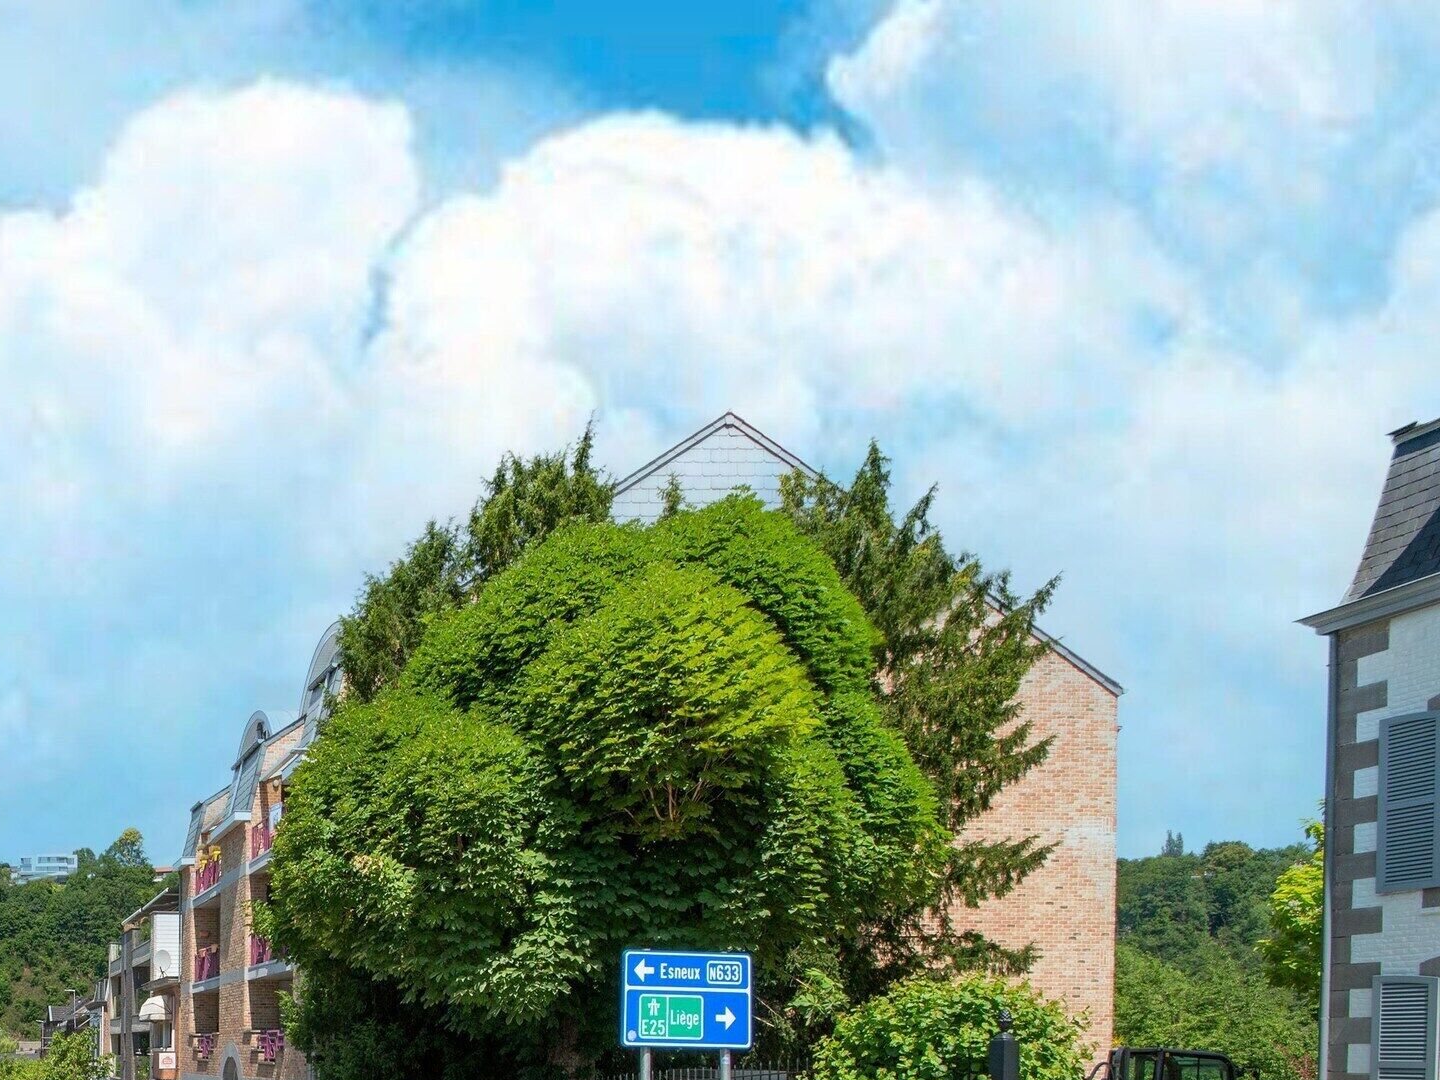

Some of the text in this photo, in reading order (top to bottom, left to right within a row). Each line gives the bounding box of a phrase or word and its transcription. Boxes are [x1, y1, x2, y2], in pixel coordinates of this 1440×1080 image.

[660, 962, 739, 981] Esneux N633
[642, 1019, 665, 1035] E25
[670, 1010, 699, 1029] Liège
